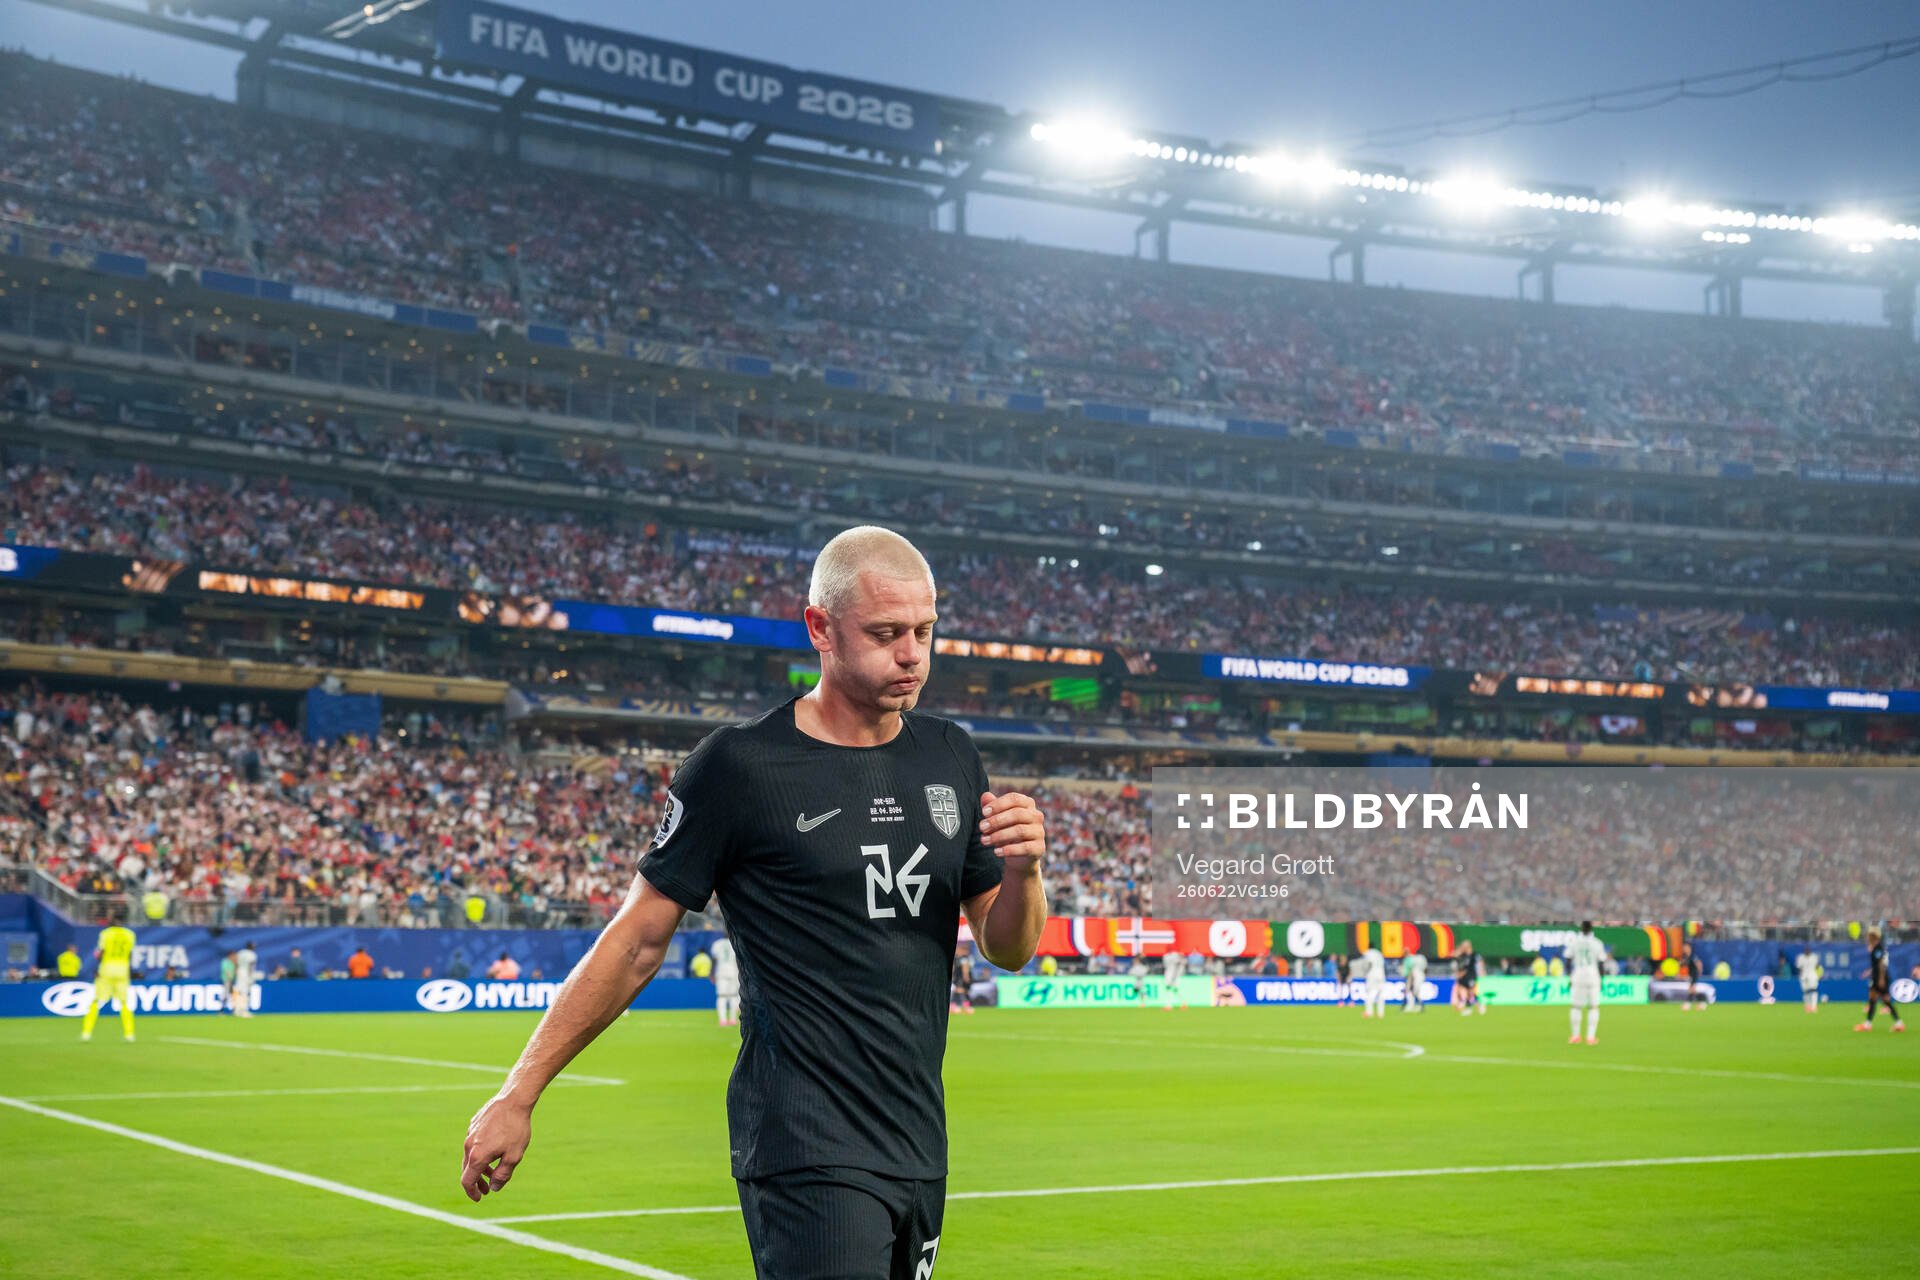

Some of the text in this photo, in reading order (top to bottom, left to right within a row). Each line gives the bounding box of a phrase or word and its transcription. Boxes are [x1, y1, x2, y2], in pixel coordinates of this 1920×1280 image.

[469, 13, 915, 130] FIFA WORLD CUP 2026
[1221, 656, 1258, 678] FIFA
[1257, 659, 1319, 682] WORLD
[1318, 662, 1351, 683] CUP
[860, 843, 931, 919] 26
[131, 944, 189, 969] FIFA
